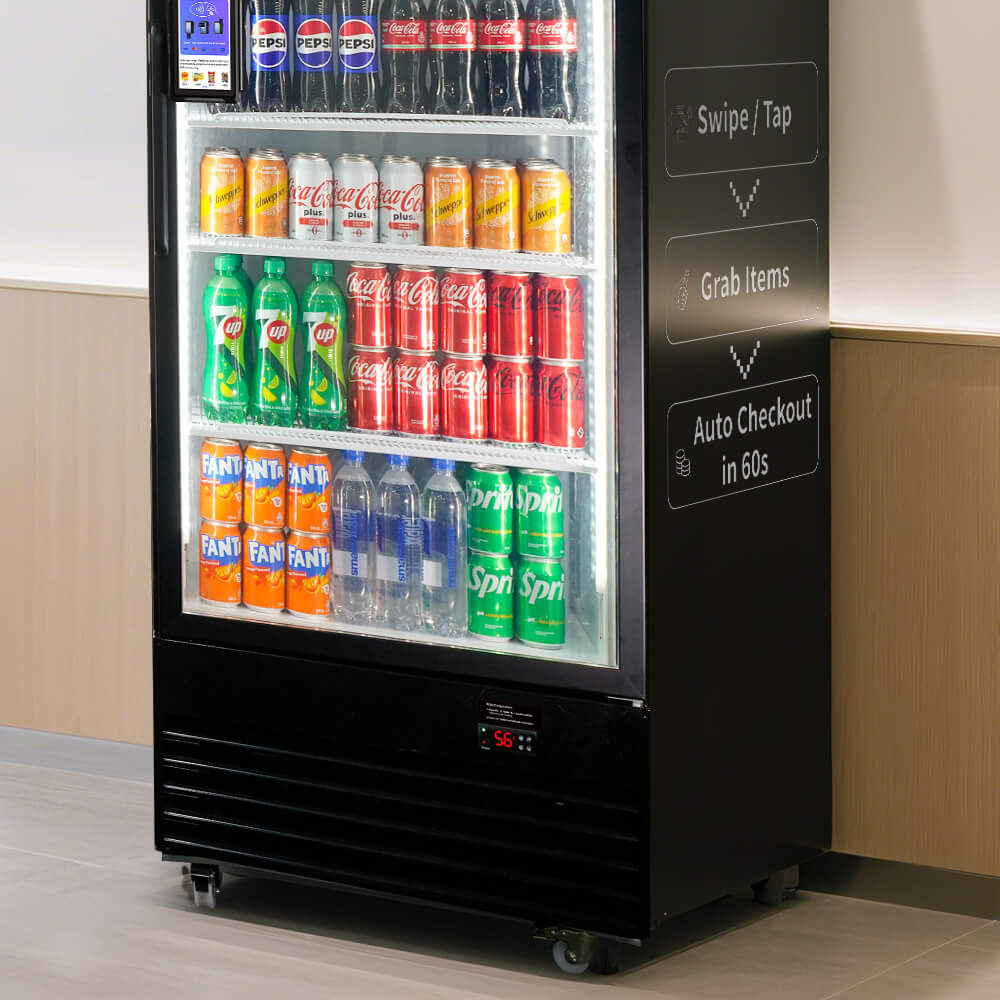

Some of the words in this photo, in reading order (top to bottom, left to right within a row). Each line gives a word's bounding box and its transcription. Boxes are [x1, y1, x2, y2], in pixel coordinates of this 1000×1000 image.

[297, 38, 331, 49] PEPSI
[340, 38, 374, 49] PEPSI
[697, 101, 749, 140] Swipe
[763, 100, 792, 134] Tap
[303, 208, 324, 217] plus
[348, 210, 368, 219] plus
[393, 212, 414, 221] plus
[701, 266, 741, 301] Grab
[745, 265, 790, 294] Items
[693, 413, 733, 446] Auto
[737, 392, 812, 434] Checkout
[722, 455, 737, 486] in
[741, 450, 769, 480] 60s
[466, 480, 512, 510] Sprit
[516, 484, 562, 516] Spri
[201, 534, 241, 557] FANT
[249, 541, 285, 564] FANT
[469, 566, 513, 598] Spri
[519, 571, 565, 605] Spri
[494, 730, 512, 748] 56
